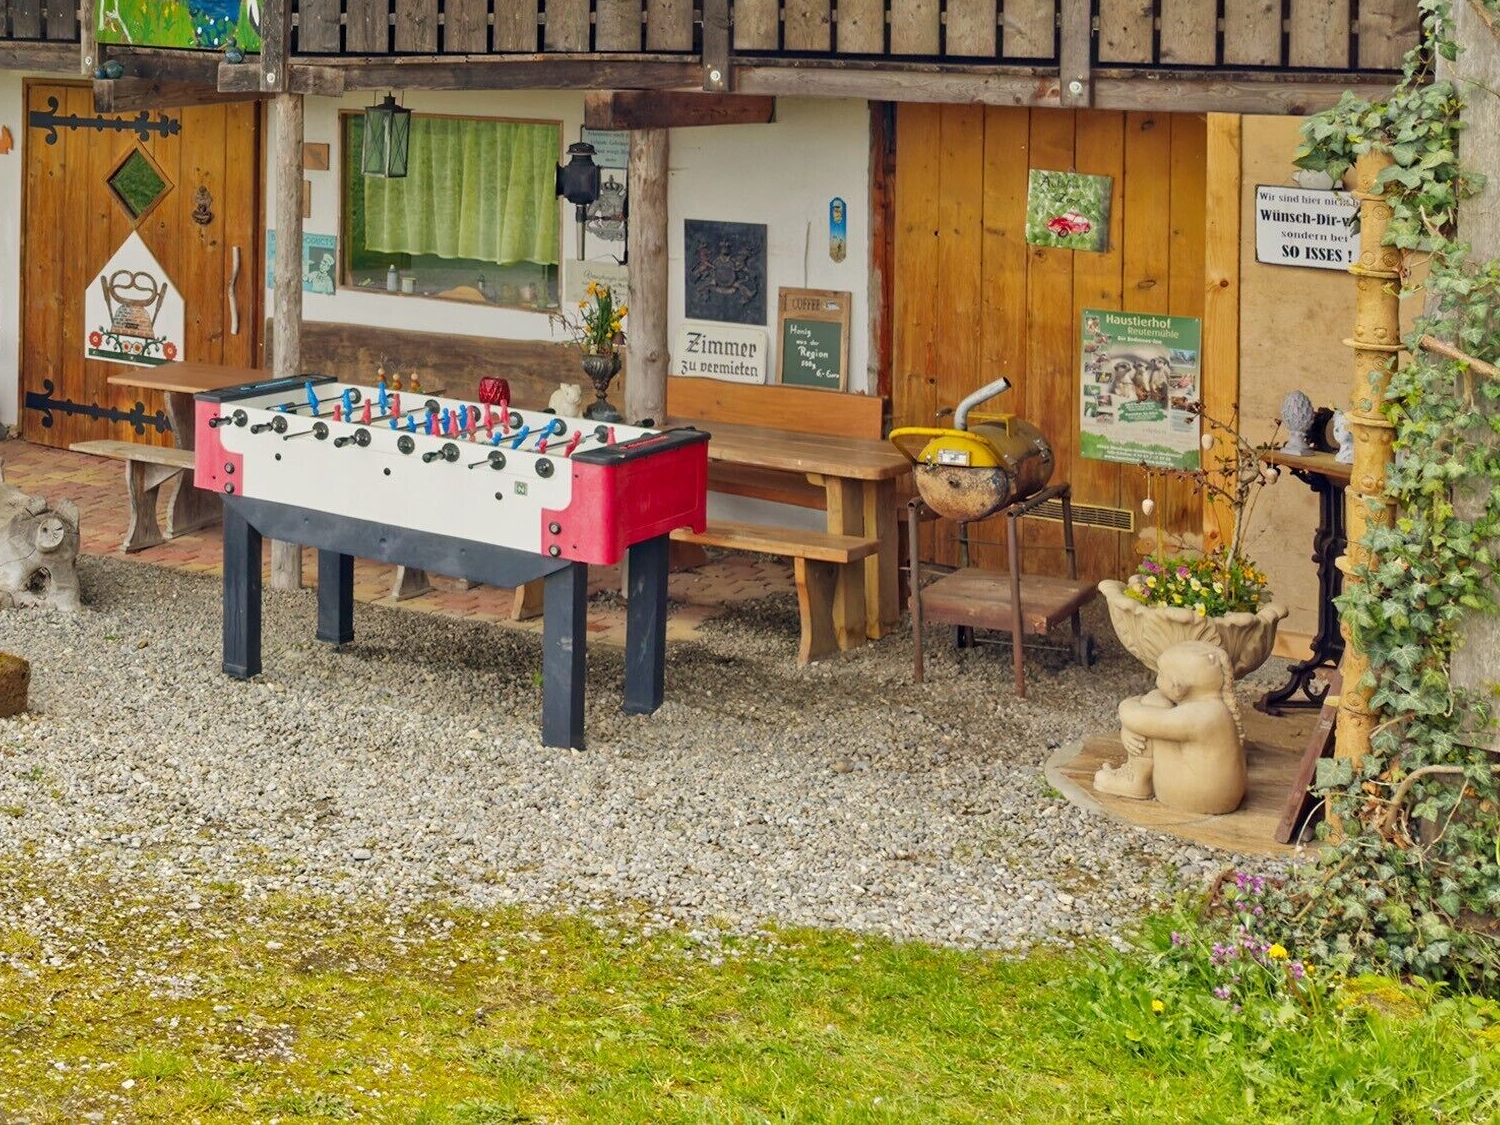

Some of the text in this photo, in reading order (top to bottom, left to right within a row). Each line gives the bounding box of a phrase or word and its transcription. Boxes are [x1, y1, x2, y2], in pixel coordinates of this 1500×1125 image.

[1260, 192, 1275, 201] Wir
[1279, 194, 1300, 204] sind
[1302, 195, 1321, 205] hier
[1281, 230, 1328, 241] sondern
[1281, 244, 1300, 259] SO
[1305, 246, 1343, 262] ISSES
[792, 297, 820, 311] COFFEE
[1106, 314, 1172, 329] Haustierhof
[790, 324, 812, 337] Honig
[1127, 327, 1180, 339] Reutemühle
[685, 332, 757, 358] Zimmer
[798, 346, 829, 360] Region
[681, 360, 758, 377] zu vermieten
